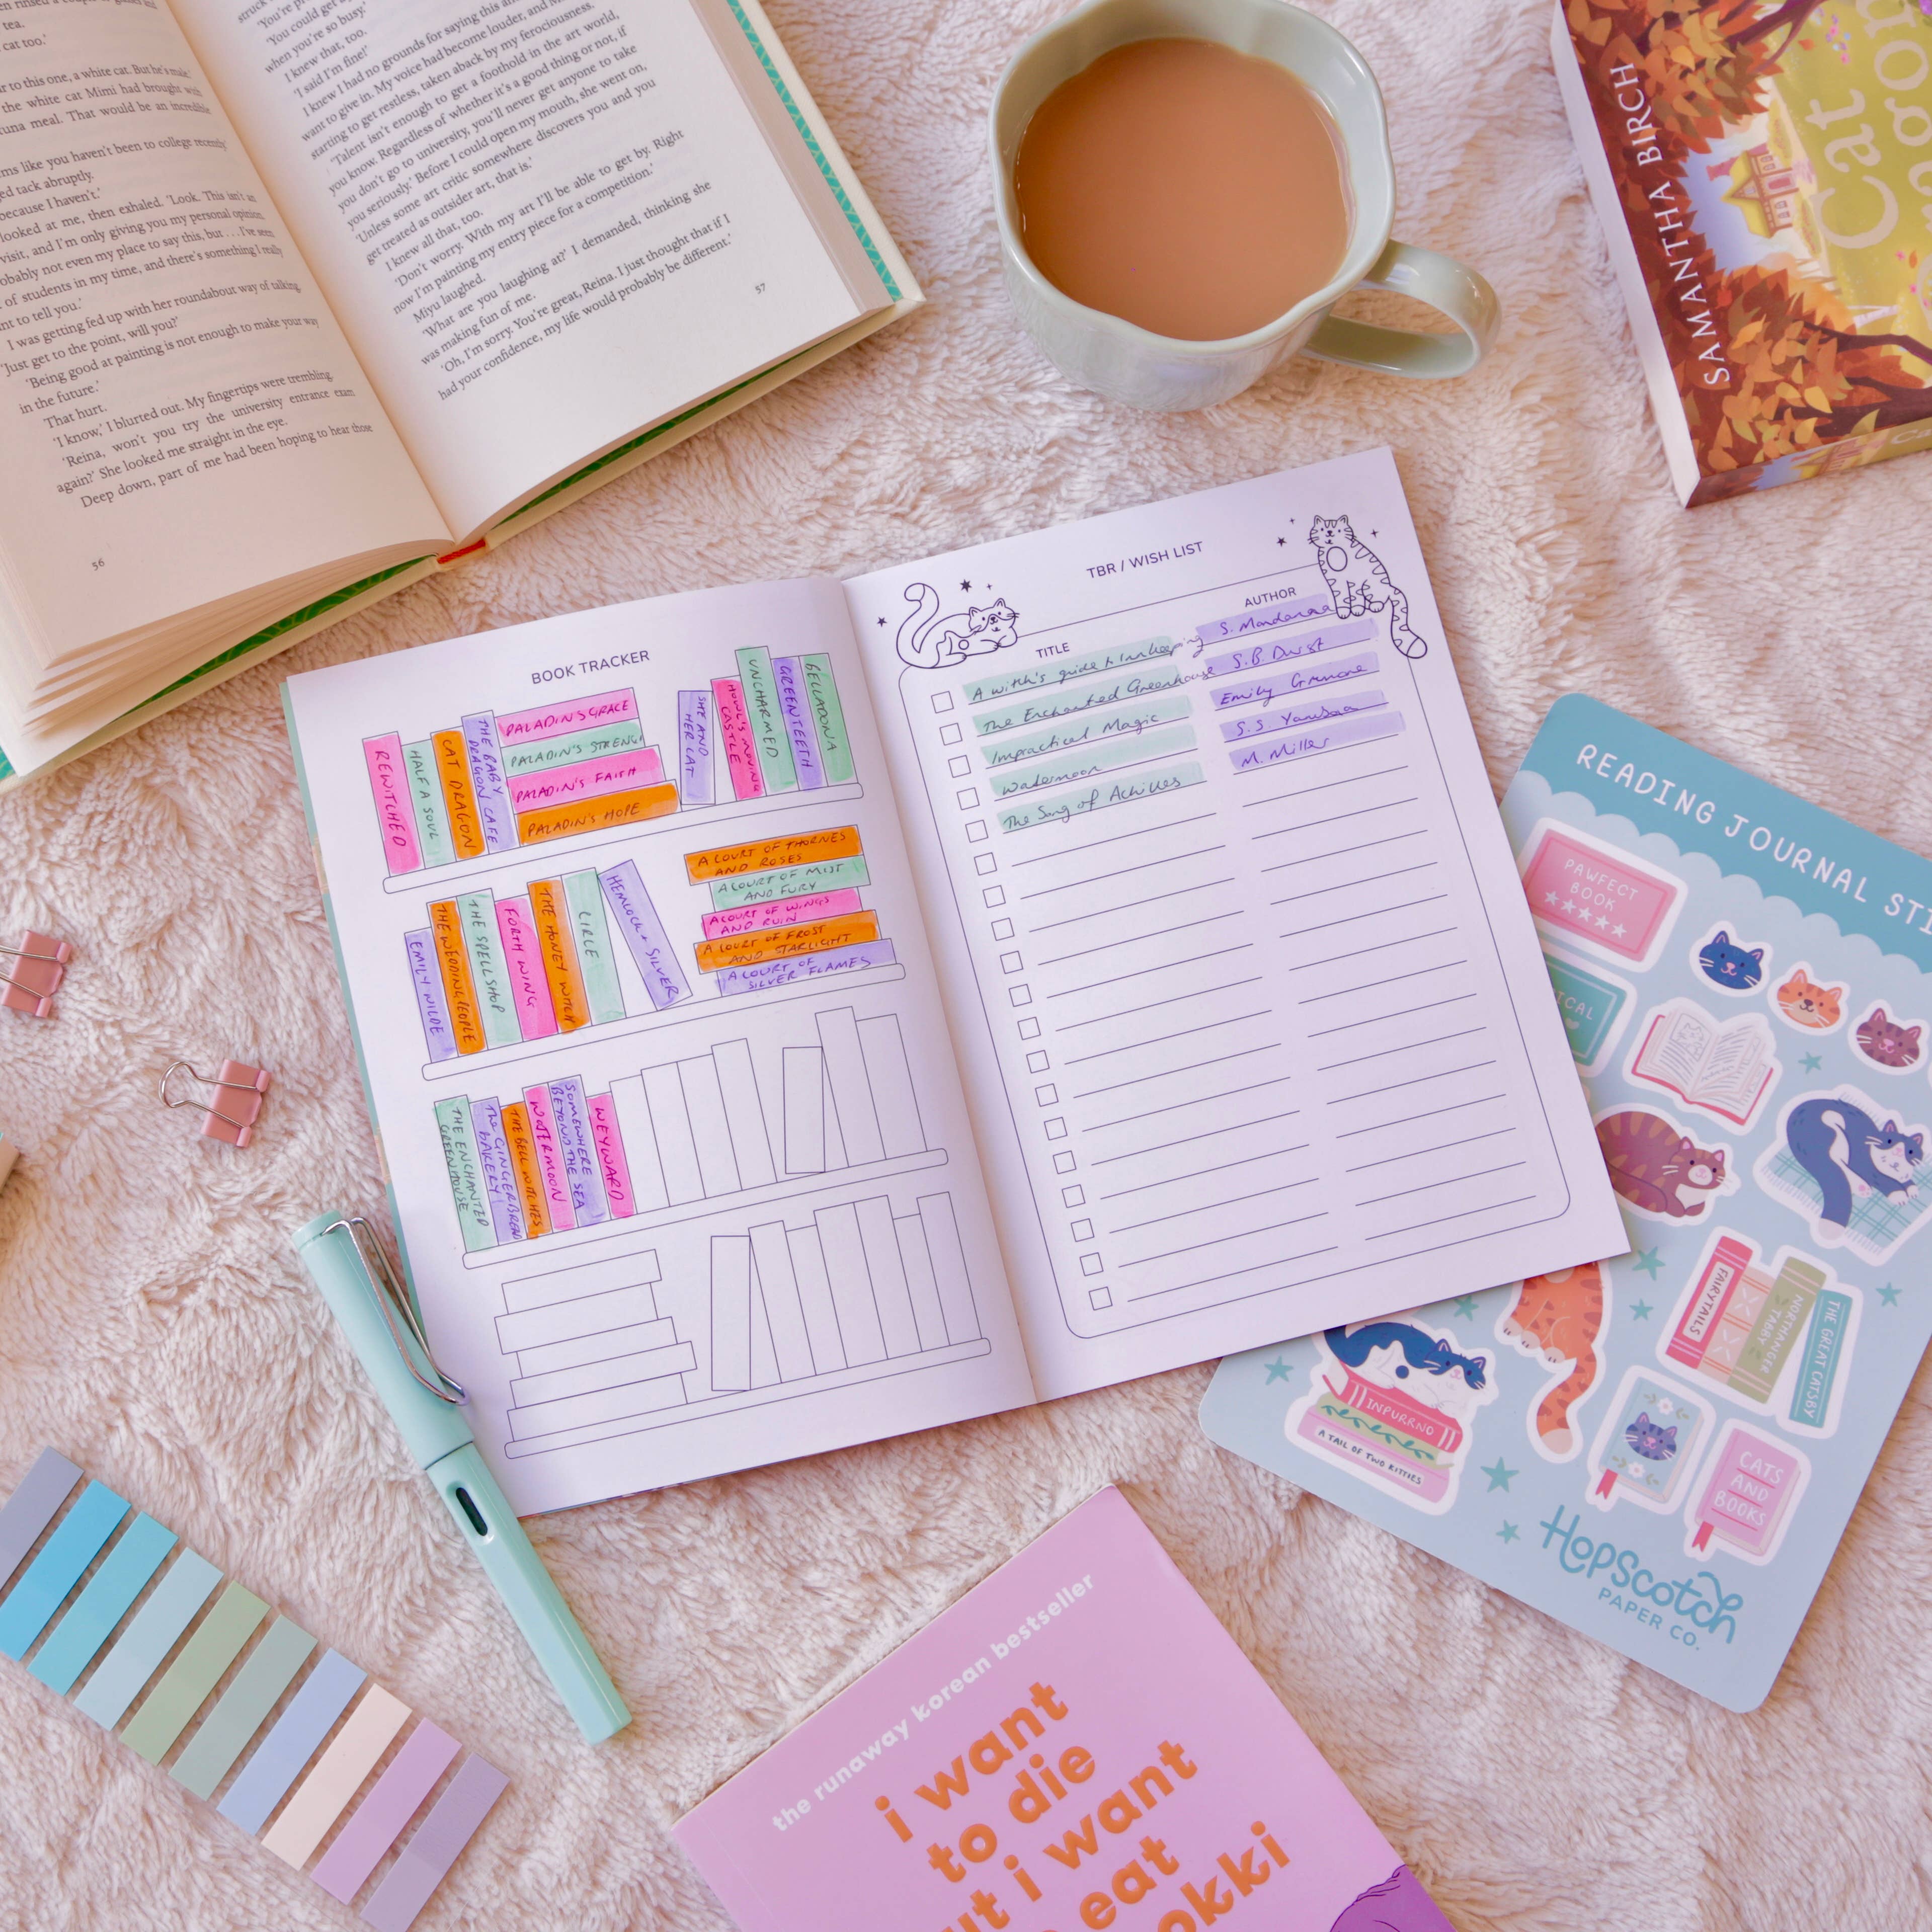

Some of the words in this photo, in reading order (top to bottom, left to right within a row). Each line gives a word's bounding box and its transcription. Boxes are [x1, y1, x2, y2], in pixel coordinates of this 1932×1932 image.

[311, 131, 348, 160] starting
[348, 123, 359, 133] to
[361, 113, 382, 128] get
[379, 91, 425, 115] restless,
[422, 73, 451, 90] taken
[454, 57, 484, 74] aback
[486, 48, 502, 63] by
[501, 38, 521, 56] my
[521, 3, 594, 41] ferociousness.
[1610, 63, 1663, 167] BIRCH
[1806, 89, 1898, 250] Cat
[755, 283, 765, 294] 57
[1649, 179, 1731, 385] SAMANTHA
[438, 381, 458, 400] had
[458, 368, 481, 390] your
[484, 335, 543, 371] confidence,
[543, 322, 561, 336] my
[562, 311, 581, 326] life
[582, 291, 617, 315] would
[618, 270, 664, 301] probably
[665, 263, 681, 273] be
[43, 414, 74, 428] That
[75, 405, 107, 419] hurt.
[80, 492, 114, 508] Deep
[118, 479, 155, 495] down,
[158, 469, 183, 486] part
[187, 464, 199, 473] of
[203, 457, 221, 468] me
[225, 451, 247, 462] had
[92, 558, 105, 571] 56
[1087, 563, 1116, 579] TBR
[1130, 550, 1170, 568] WISH
[1175, 541, 1204, 557] LIST
[1245, 588, 1297, 607] AUTHOR
[532, 665, 576, 684] BOOK
[579, 651, 650, 673] TRACKER
[1036, 642, 1070, 658] TITLE
[589, 700, 629, 718] GRACE
[698, 696, 706, 719] SHE
[749, 660, 778, 757] UNCHARMED
[973, 687, 982, 701] A
[1221, 687, 1275, 706] Emily
[477, 720, 493, 747] THE
[684, 714, 693, 740] HER
[780, 666, 813, 767] GREENTEETH
[1103, 714, 1159, 735] Magic
[442, 739, 460, 768] CAT
[697, 724, 708, 756] AND
[722, 707, 741, 764] CASTLE
[1270, 738, 1330, 759] Miller
[482, 754, 503, 794] BABY
[595, 767, 636, 782] FAITH
[685, 748, 696, 777] CAT
[411, 750, 430, 786] HALF
[425, 807, 438, 840] SOUL
[469, 741, 490, 799] DRAGON
[486, 807, 499, 844] CAFE
[604, 802, 640, 819] HOPE
[1038, 803, 1070, 824] Song
[1078, 789, 1098, 811] of
[449, 780, 476, 848] DRAGON
[1576, 744, 1716, 825] READING
[1725, 814, 1868, 903] JOURNAL
[698, 857, 708, 866] A
[715, 849, 756, 862] COURT
[764, 843, 781, 853] OF
[715, 864, 748, 876] AND
[759, 854, 802, 867] ROSES
[744, 888, 773, 900] AND
[781, 882, 817, 894] FURY
[1565, 858, 1638, 901] PAWFECT
[1570, 882, 1616, 912] BOOK
[468, 900, 486, 927] THE
[539, 888, 555, 915] THE
[545, 923, 568, 972] HONEY
[607, 875, 641, 933] HEMLOCK
[646, 948, 679, 999] SILVER
[729, 951, 763, 963] AND
[775, 933, 851, 954] STARLIGHT
[786, 925, 826, 939] FROST
[432, 906, 451, 931] THE
[456, 1002, 476, 1043] PEOPLE
[505, 908, 524, 951] FORTH
[519, 962, 534, 1008] WING
[729, 971, 737, 981] A
[743, 963, 790, 979] COURT
[799, 958, 815, 967] OF
[749, 972, 798, 990] SILVER
[809, 956, 871, 975] FLAMES
[410, 941, 430, 984] EMILY
[424, 994, 444, 1034] WILDE
[558, 983, 575, 1024] WITCH
[452, 1107, 463, 1134] THE
[510, 1110, 522, 1133] THE
[565, 1084, 592, 1175] SOMEWHERE
[515, 1138, 528, 1164] BELL
[551, 1087, 572, 1146] BEYOND
[564, 1150, 577, 1175] THE
[573, 1183, 585, 1209] SEA
[596, 1107, 624, 1200] WEYWARD
[455, 1141, 489, 1227] ENCHANTED
[1689, 1268, 1728, 1336] FAIRYTAILS
[1824, 1301, 1840, 1325] THE
[1758, 1309, 1782, 1346] TABBY
[1759, 1295, 1804, 1376] NORTHANGER
[1815, 1328, 1835, 1369] GREAT
[1803, 1373, 1822, 1419] CATSBY
[1367, 1397, 1435, 1437] INPURRNO
[1318, 1430, 1327, 1441] A
[1329, 1433, 1350, 1448] TAIL
[1351, 1444, 1363, 1455] OF
[1365, 1450, 1386, 1466] TWO
[1388, 1460, 1423, 1485] KITTIES
[1740, 1451, 1785, 1485] CATS
[1731, 1474, 1769, 1502] AND
[1715, 1490, 1765, 1526] BOOKS
[1598, 1587, 1662, 1629] PAPER
[1668, 1625, 1700, 1651] CO.
[772, 1794, 812, 1834] the
[813, 1715, 911, 1802] runaway
[910, 1656, 992, 1723] korean
[989, 1572, 1096, 1658] bestseller
[874, 1796, 914, 1843] i
[913, 1680, 1069, 1811] want
[1007, 1744, 1096, 1824] die
[1003, 1855, 1043, 1903] i
[1042, 1739, 1198, 1870] want
[1079, 1835, 1180, 1930] eat
